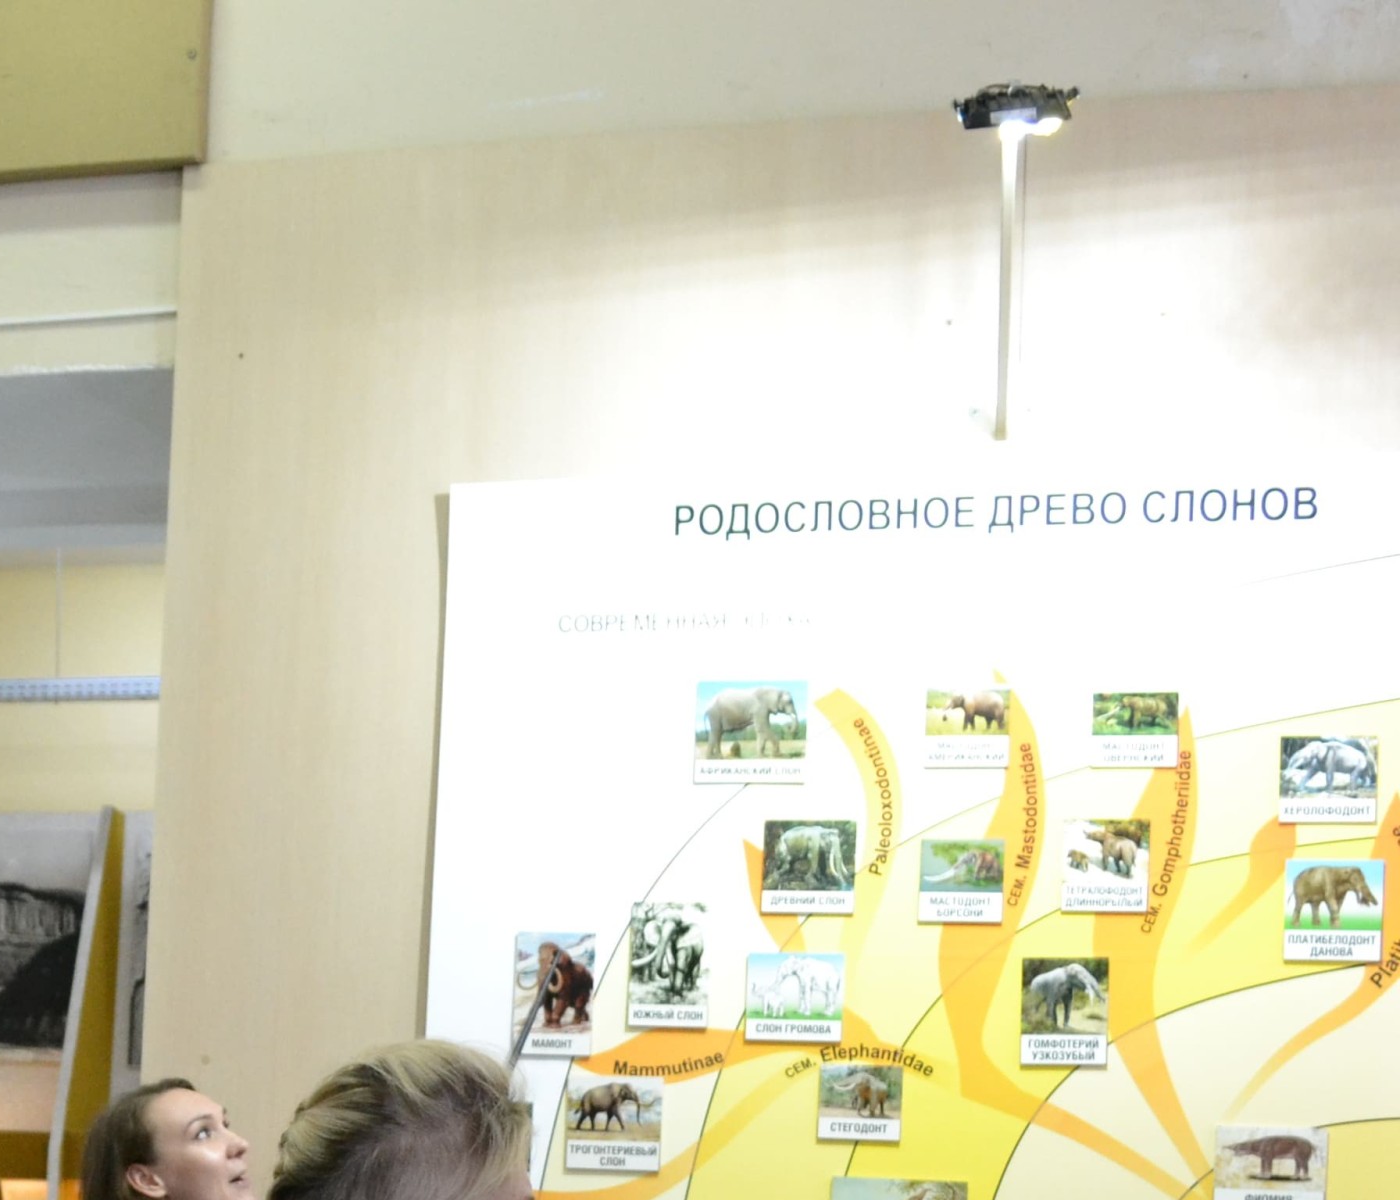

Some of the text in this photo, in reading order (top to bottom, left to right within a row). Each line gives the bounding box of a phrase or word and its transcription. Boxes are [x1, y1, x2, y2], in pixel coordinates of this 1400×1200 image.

[674, 486, 1319, 541] РОДОСЛОВНОЕ ДРЕВО СЛОНОВ
[853, 717, 894, 876] Paleoloxodontinae
[1015, 742, 1038, 870] Mastodontidae
[1283, 806, 1371, 817] ХЕРОЛОФОДОНТ
[1152, 750, 1192, 897] Gomphotheriidae
[1066, 885, 1144, 896] ТЕТРАЛОФОДОНТ
[770, 895, 846, 906] ДРЕВНИЙ СЛОН
[929, 896, 991, 907] МАСТОДОНТ
[1065, 898, 1144, 908] ДЛИННОРЫЛЫЙ
[936, 907, 984, 917] БОРСОНИ
[1287, 934, 1377, 947] ПЛАТИБЕЛОДОНТ
[1310, 946, 1354, 958] ДАНОВА
[632, 1008, 704, 1021] ЮЖНЫЙ СЛОН
[755, 1023, 832, 1035] СЛОН ГРОМОВА
[531, 1038, 573, 1049] МАМОНТ
[1027, 1037, 1100, 1050] ГОМФОТЕРИЙ
[819, 1044, 934, 1077] Elephantidae
[1031, 1049, 1096, 1061] УЗКОЗУБЫЙ
[612, 1051, 725, 1077] Mammutinae
[829, 1122, 888, 1134] СТЕГОДОНТ
[569, 1143, 658, 1156] ТРОГОНТЕРИЕВЫЙ
[599, 1156, 626, 1167] СЛОН
